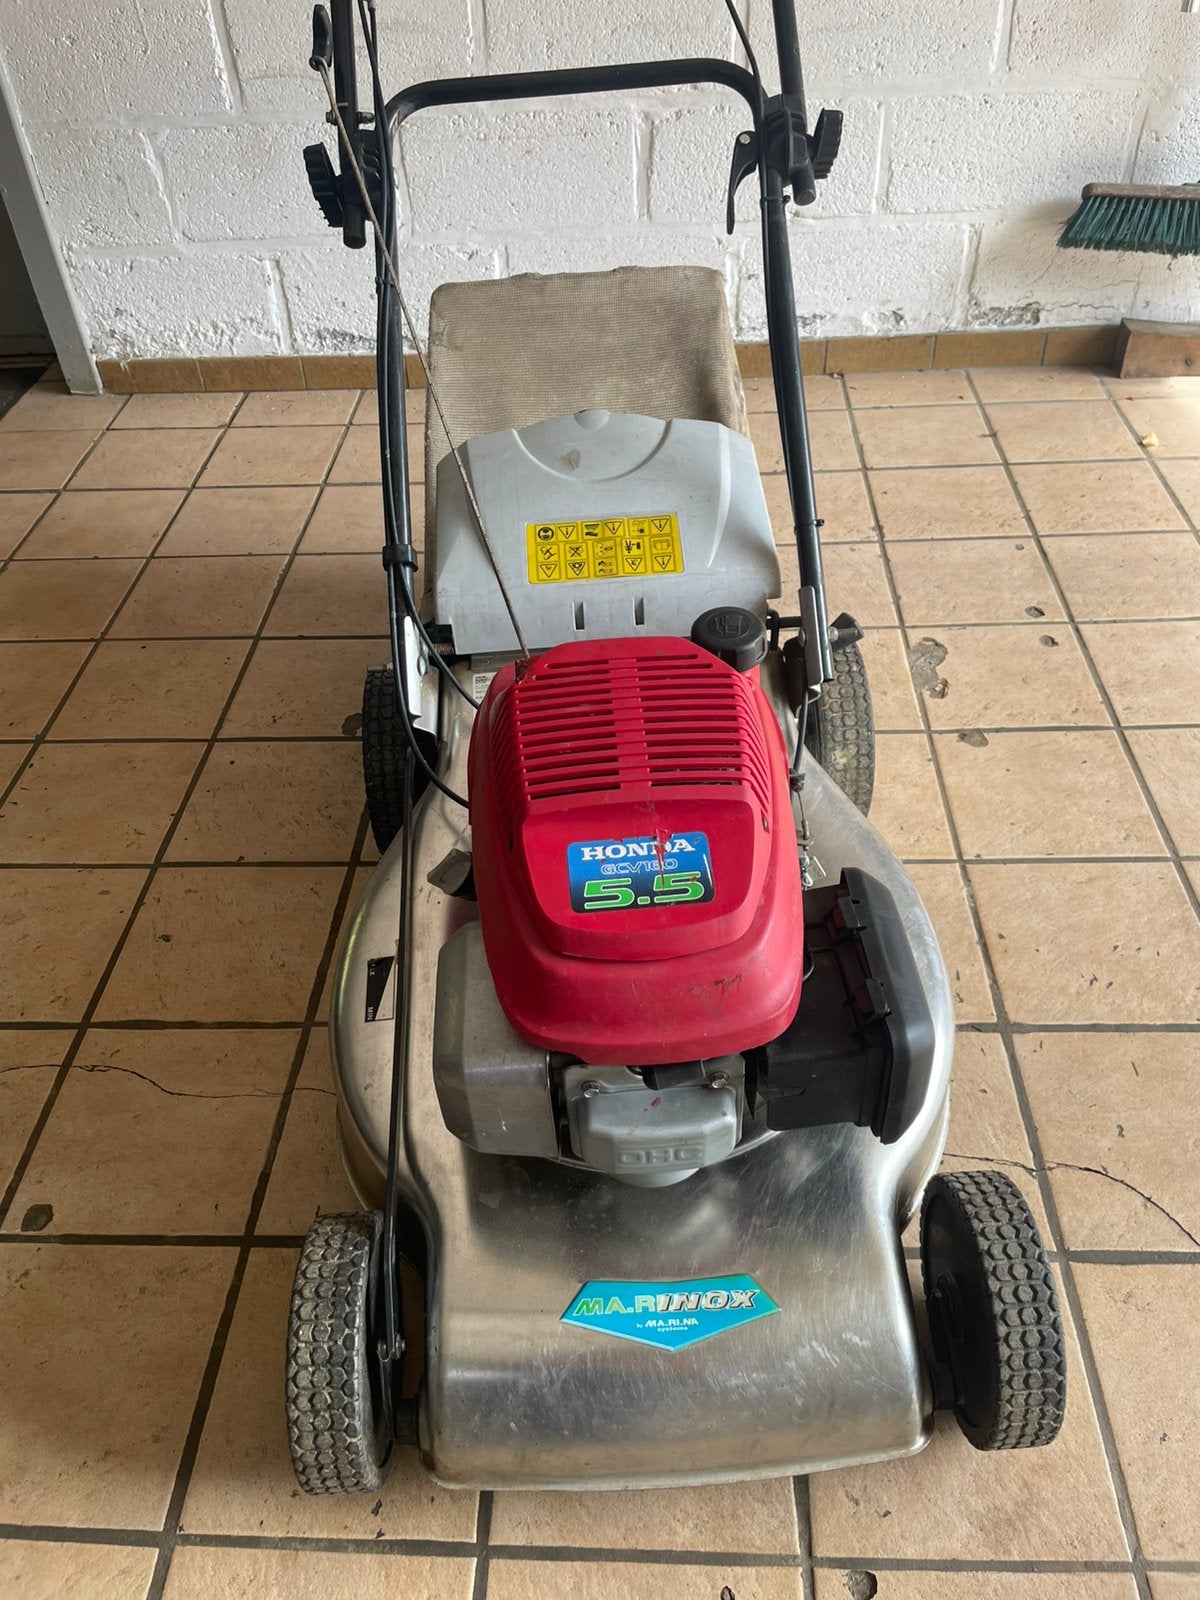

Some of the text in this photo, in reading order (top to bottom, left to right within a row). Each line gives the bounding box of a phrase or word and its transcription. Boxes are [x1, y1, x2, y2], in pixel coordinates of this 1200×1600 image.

[581, 838, 696, 861] HONDA
[584, 871, 705, 909] 5.5
[645, 1318, 699, 1328] MA.RI.NA
